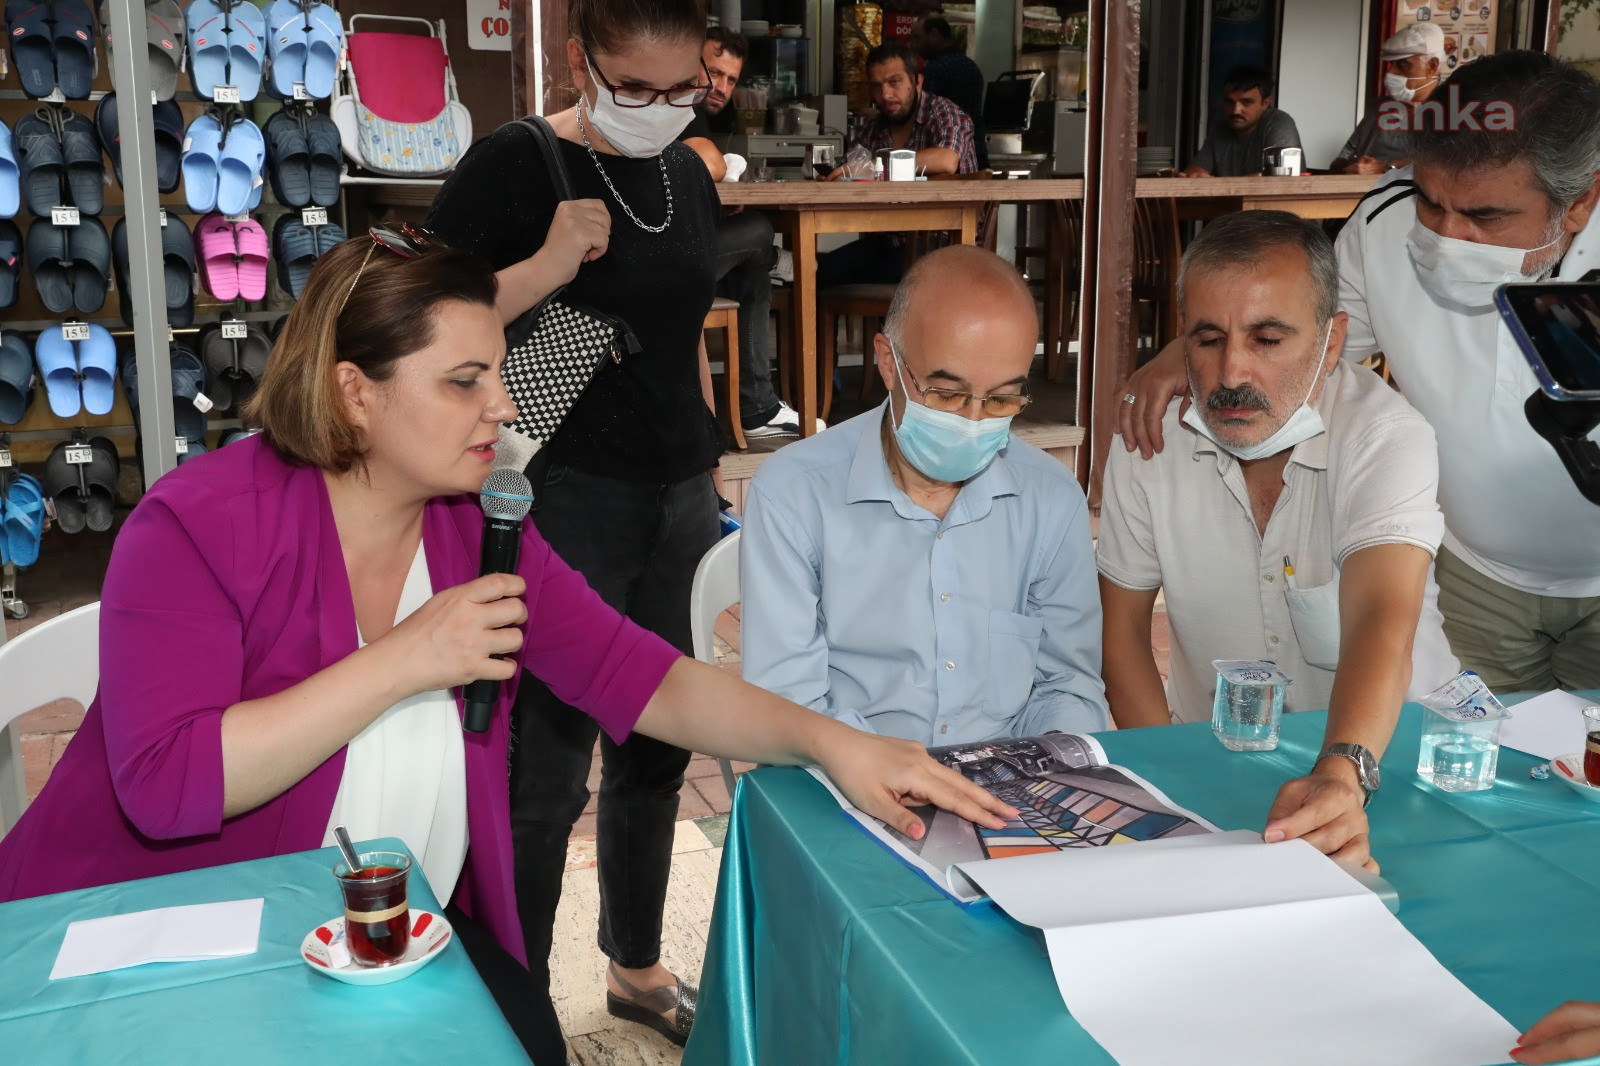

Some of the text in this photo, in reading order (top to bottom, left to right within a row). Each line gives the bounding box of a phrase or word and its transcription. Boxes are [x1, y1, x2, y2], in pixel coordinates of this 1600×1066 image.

[481, 16, 511, 38] ÇO
[216, 90, 229, 100] 15
[296, 88, 307, 98] 15
[55, 213, 68, 223] 15
[305, 214, 317, 224] 15
[65, 328, 78, 338] 15
[225, 327, 236, 336] 15
[69, 452, 81, 462] 15
